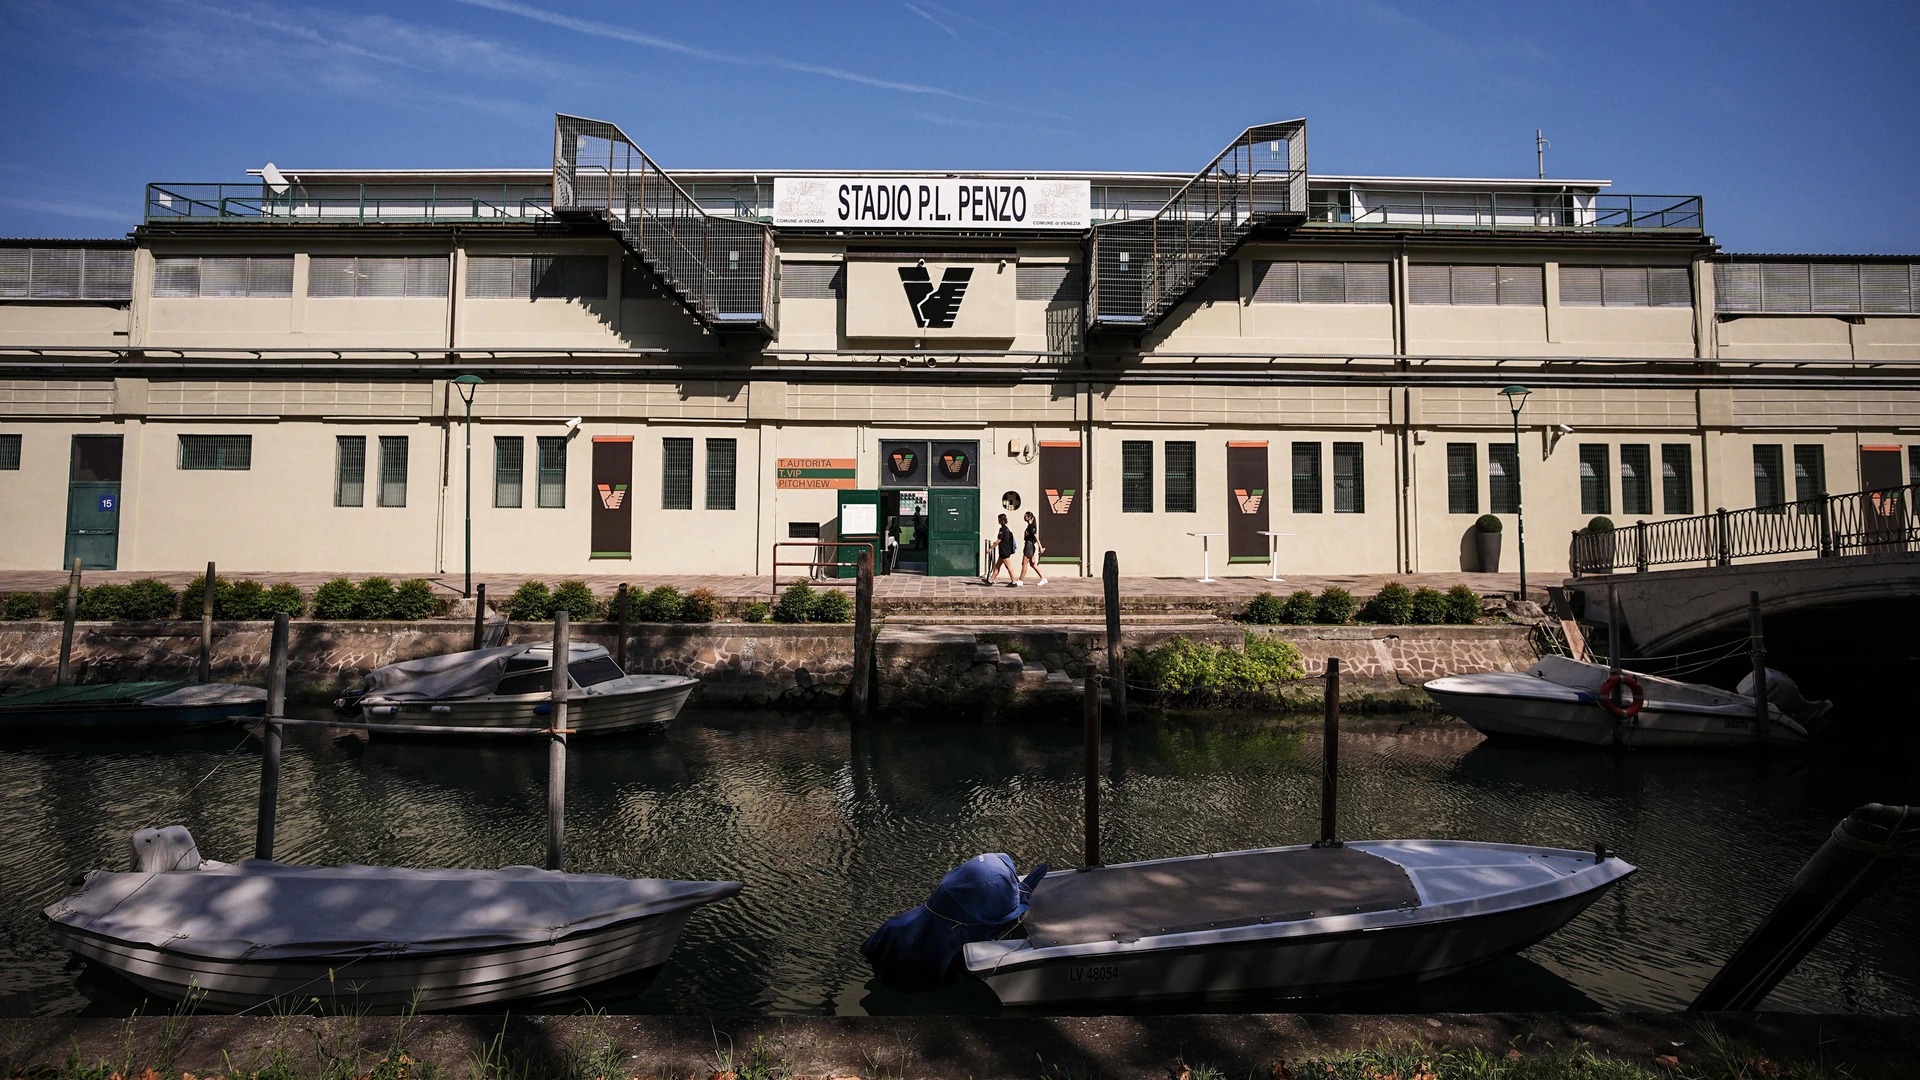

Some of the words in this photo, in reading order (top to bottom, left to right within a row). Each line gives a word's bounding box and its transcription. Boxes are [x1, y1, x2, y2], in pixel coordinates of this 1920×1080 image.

[838, 184, 912, 221] STADIO
[918, 185, 951, 221] P.L.
[958, 185, 1027, 222] PENZO
[779, 469, 786, 478] T.
[787, 469, 802, 478] VIP
[778, 480, 806, 488] PITCH
[806, 480, 830, 488] VIEW
[102, 499, 112, 507] 15
[1070, 968, 1083, 981] LV
[1087, 966, 1118, 980] 48054
